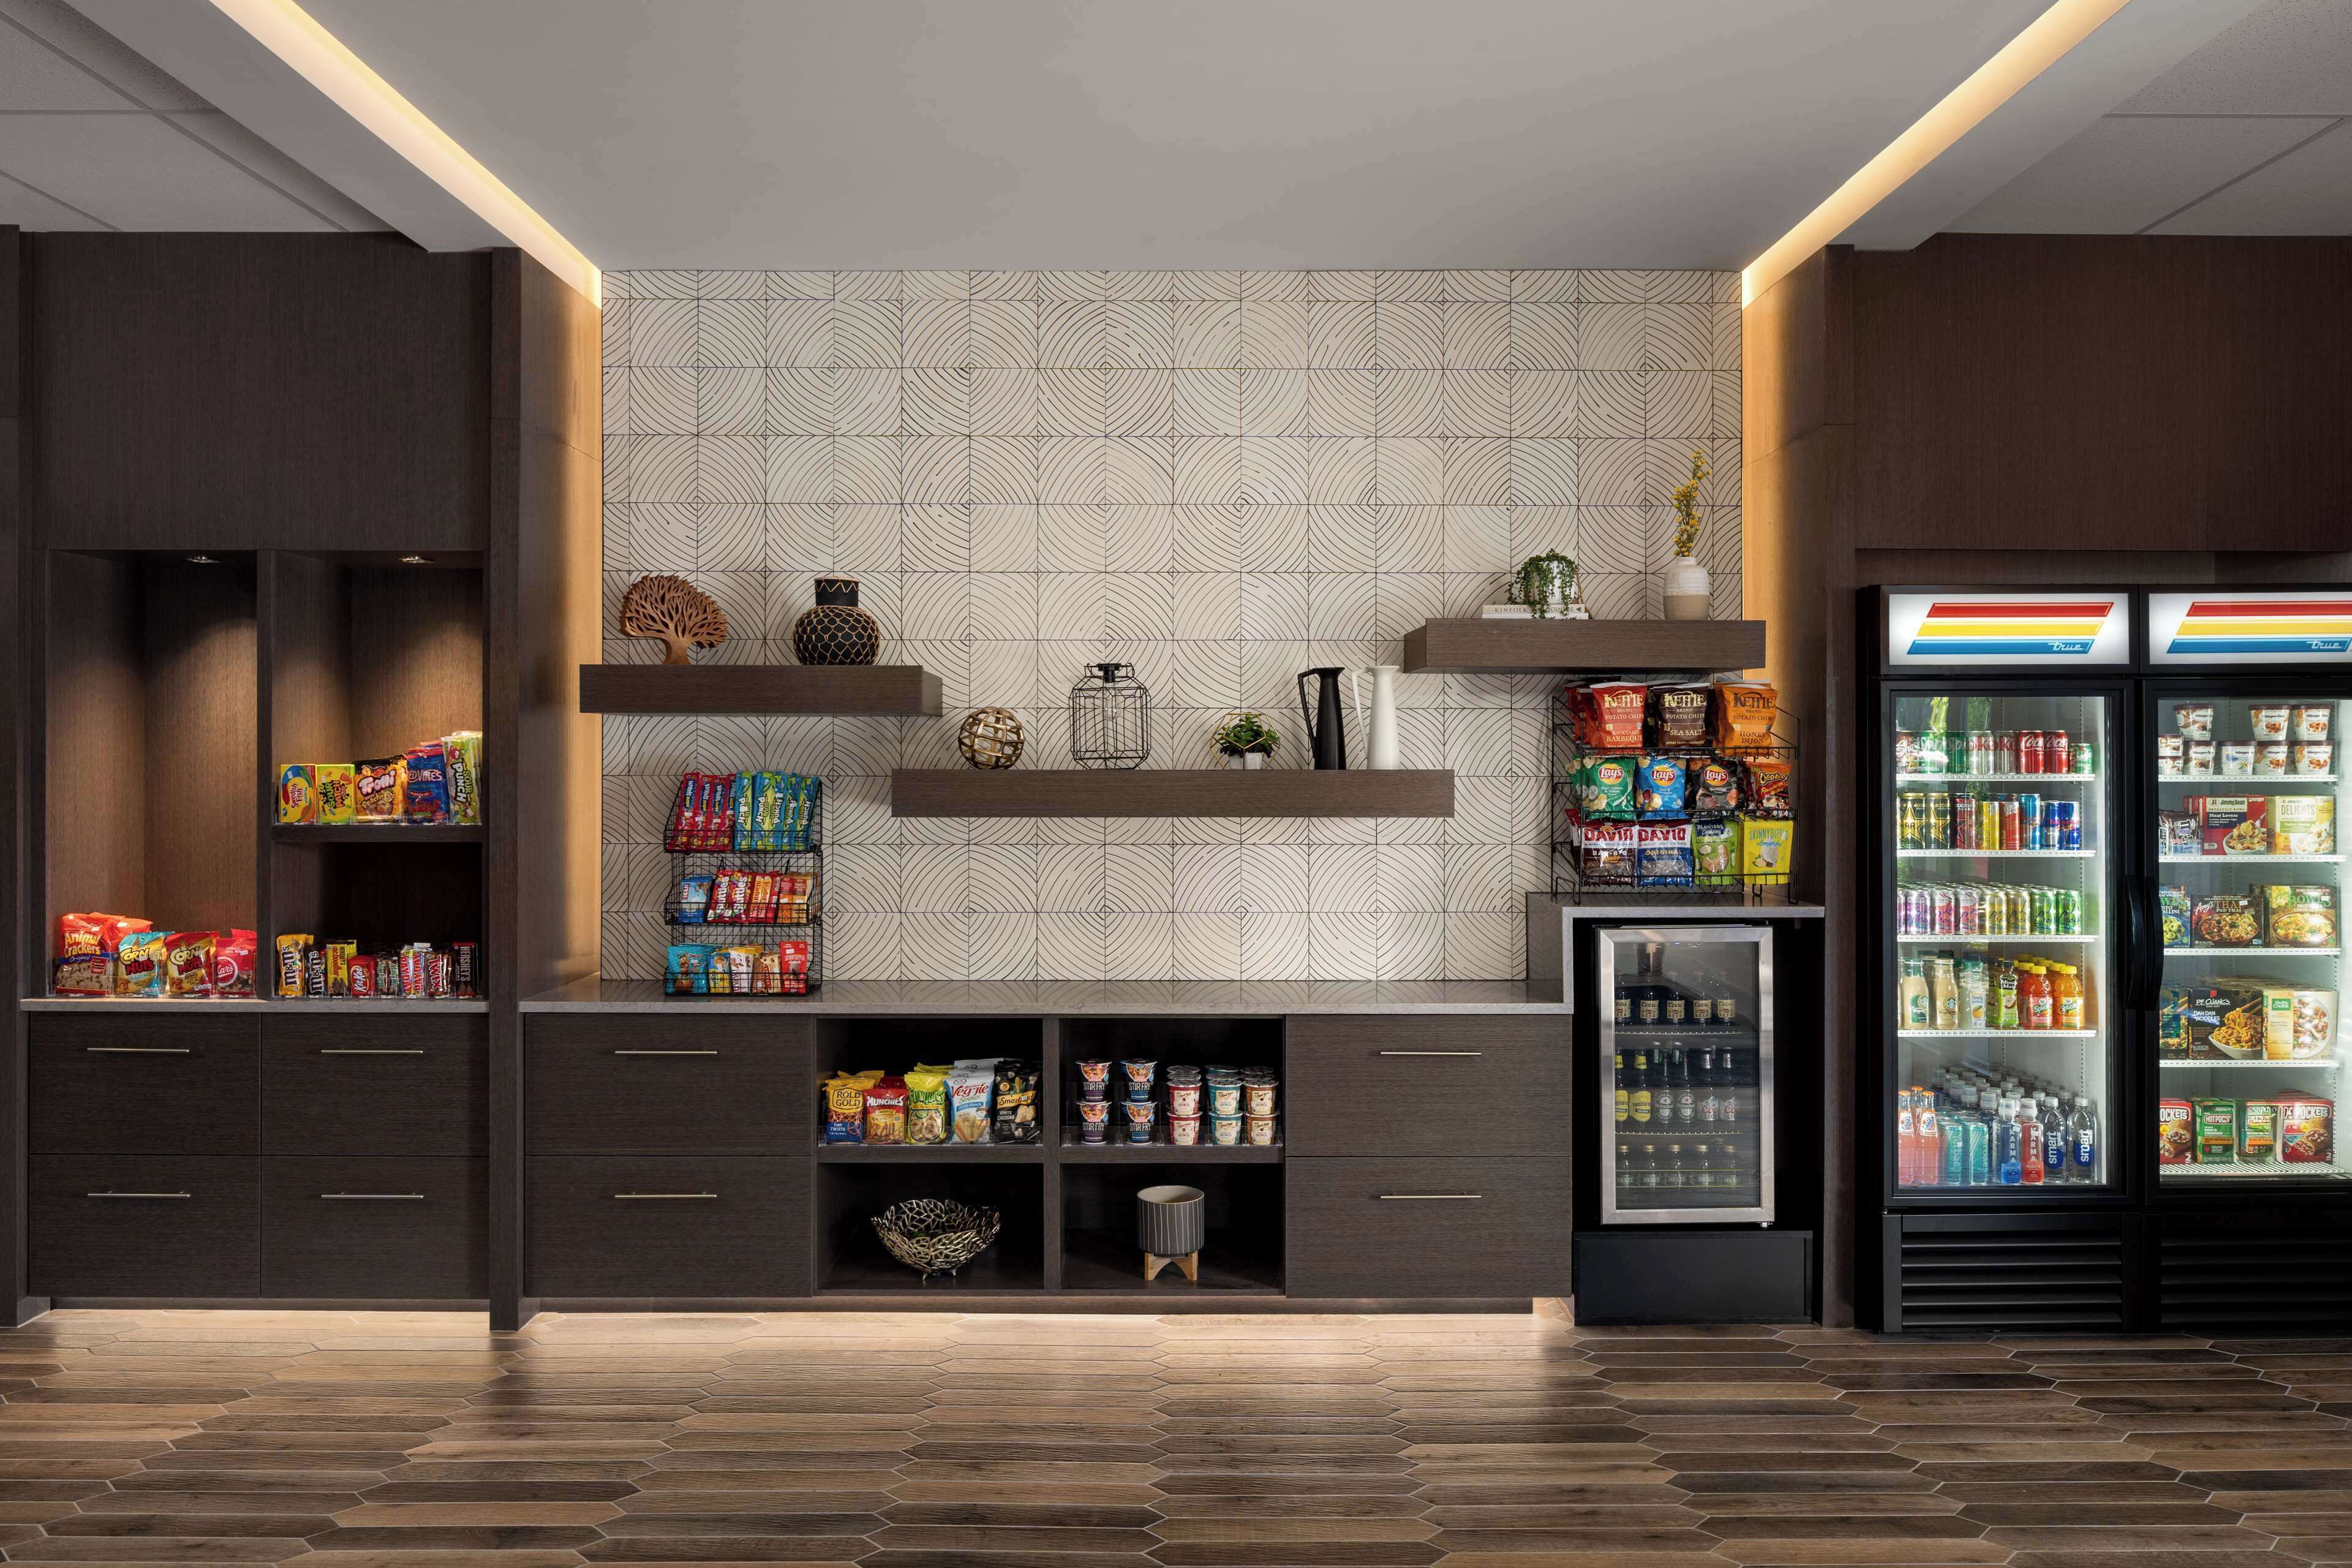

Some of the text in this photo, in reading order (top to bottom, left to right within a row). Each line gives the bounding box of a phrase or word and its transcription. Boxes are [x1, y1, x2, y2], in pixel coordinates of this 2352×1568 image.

[1602, 690, 1644, 707] KETTLE
[1663, 691, 1707, 707] KETTLE
[1732, 692, 1776, 709] KETTLE
[358, 769, 397, 795] Trolli
[1601, 768, 1622, 779] Lay's
[1654, 769, 1673, 782] Lay's
[1706, 769, 1726, 782] Lay's
[1759, 772, 1787, 785] Cheetos
[451, 762, 467, 803] PUNCH
[464, 771, 473, 794] SOUR
[290, 783, 298, 809] Swedish
[325, 782, 335, 808] SOUR
[332, 780, 345, 809] PATCH
[755, 797, 765, 823] PUNCH
[774, 799, 783, 824] PUNCH
[802, 801, 812, 825] PUNCH
[2281, 805, 2314, 815] DELIGHTS
[1584, 827, 1634, 842] DAVID
[1638, 827, 1687, 842] DAVID
[2195, 901, 2214, 915] Amy's
[2288, 895, 2332, 907] BOWLS
[64, 931, 103, 945] Animal
[64, 942, 101, 958] Crackers
[120, 948, 151, 965] CORN
[170, 946, 200, 966] CORN
[125, 959, 155, 976] NUTS
[178, 957, 205, 975] NUTS
[428, 954, 442, 991] TWIX
[460, 946, 470, 982] HERSHEY'S
[400, 955, 412, 993] PAYDAY
[413, 954, 424, 992] PAYDAY
[1084, 1082, 1105, 1090] STIR FRY
[867, 1095, 903, 1107] MUNCHIES
[1083, 1122, 1104, 1131] STIR FRY
[1129, 1123, 1151, 1131] STIR FRY
[2046, 1131, 2057, 1164] smart
[2079, 1129, 2090, 1162] smart
